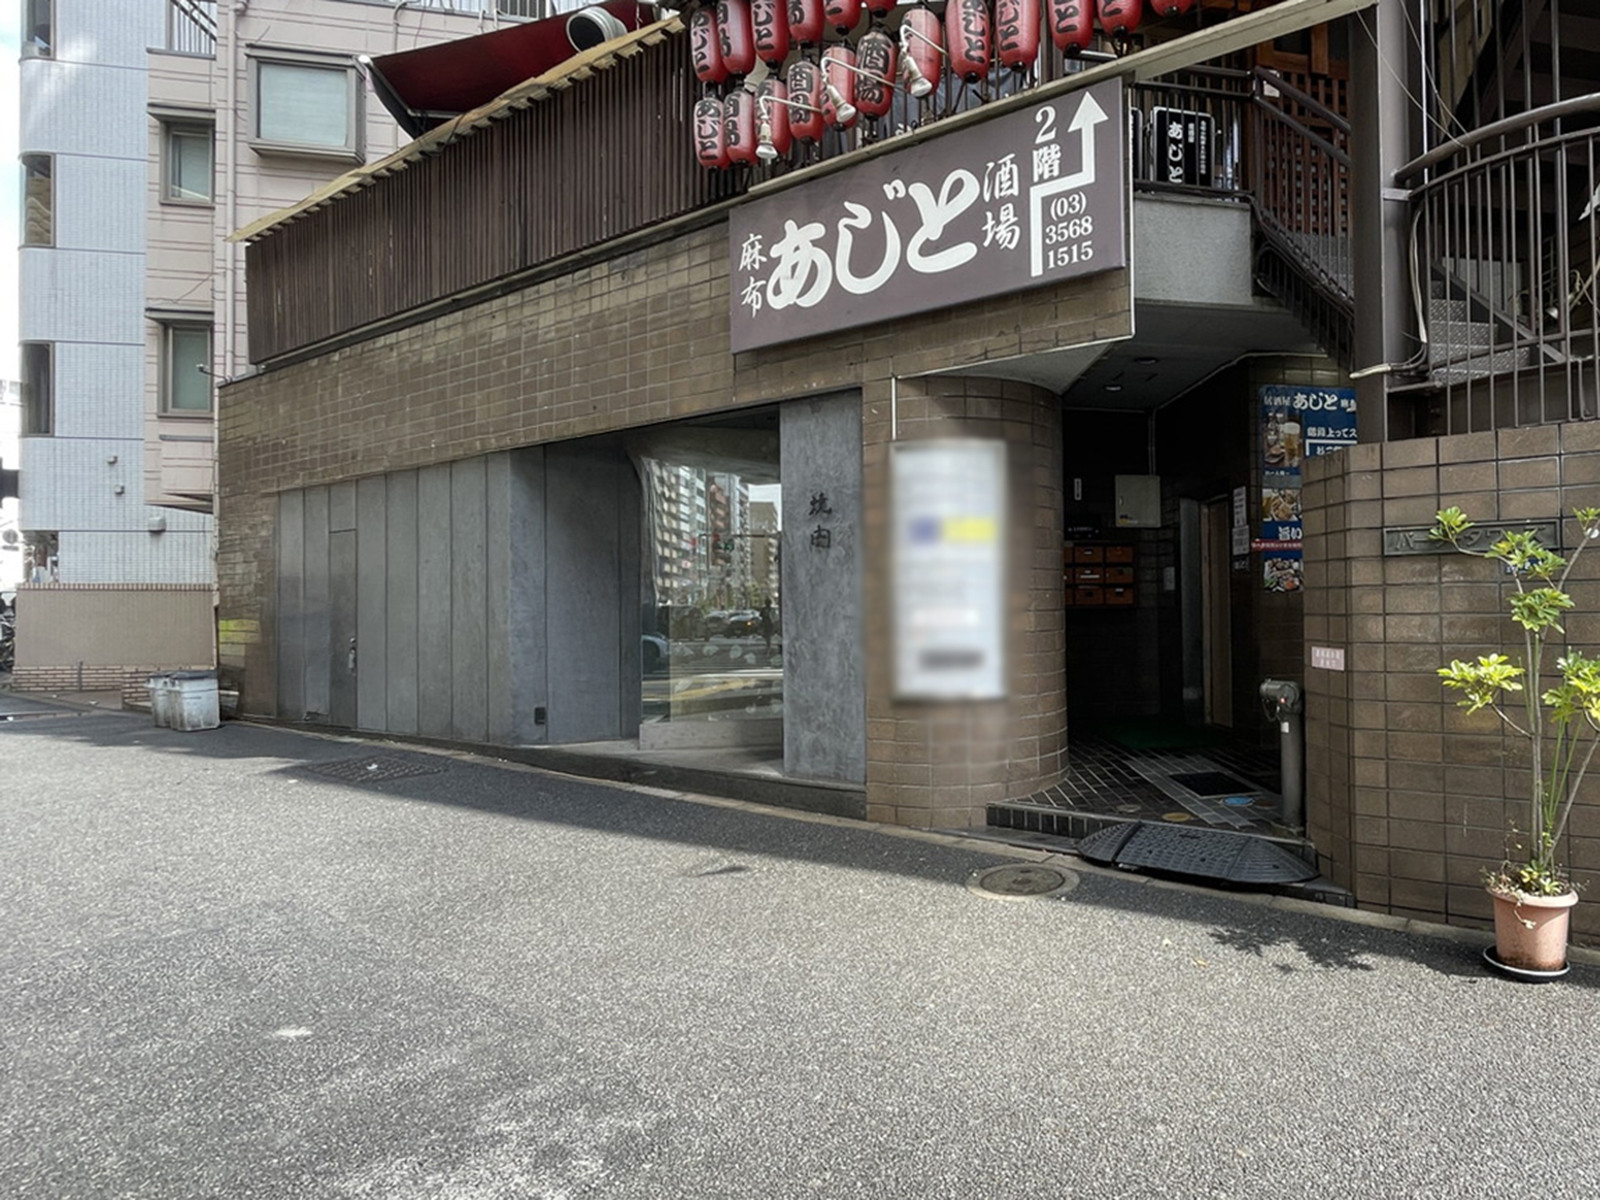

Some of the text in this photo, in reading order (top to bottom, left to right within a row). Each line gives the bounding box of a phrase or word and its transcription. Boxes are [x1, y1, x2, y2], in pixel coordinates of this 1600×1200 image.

[696, 98, 721, 160] あじと
[1168, 121, 1183, 183] あじと
[982, 152, 1021, 251] 酒場
[1045, 215, 1093, 245] 3568
[1050, 190, 1087, 219] (03)
[766, 168, 981, 310] あじと
[1047, 240, 1094, 269] 1515
[738, 232, 768, 319] 麻布
[1292, 392, 1338, 411] あじと
